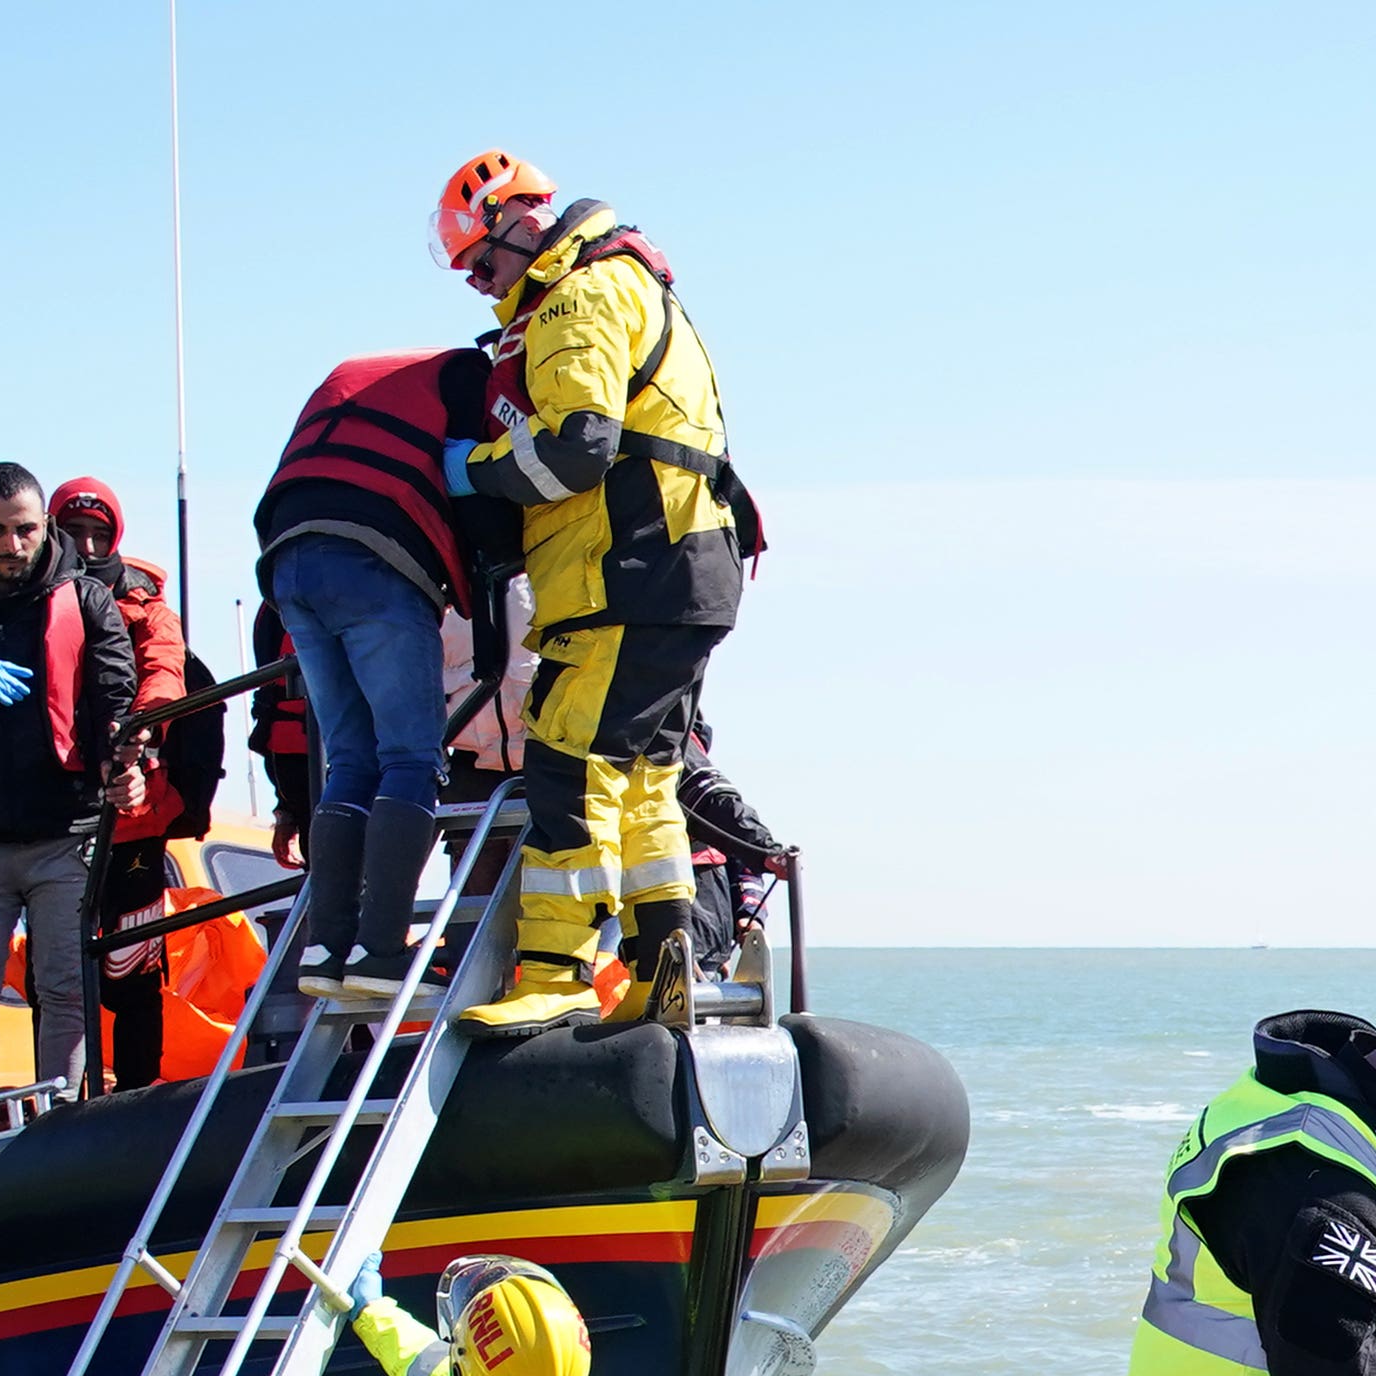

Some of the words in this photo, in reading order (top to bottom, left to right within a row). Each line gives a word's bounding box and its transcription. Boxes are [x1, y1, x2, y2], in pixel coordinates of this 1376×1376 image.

[539, 300, 578, 328] RNLI
[499, 402, 525, 426] RN
[467, 1291, 515, 1371] RNLI
